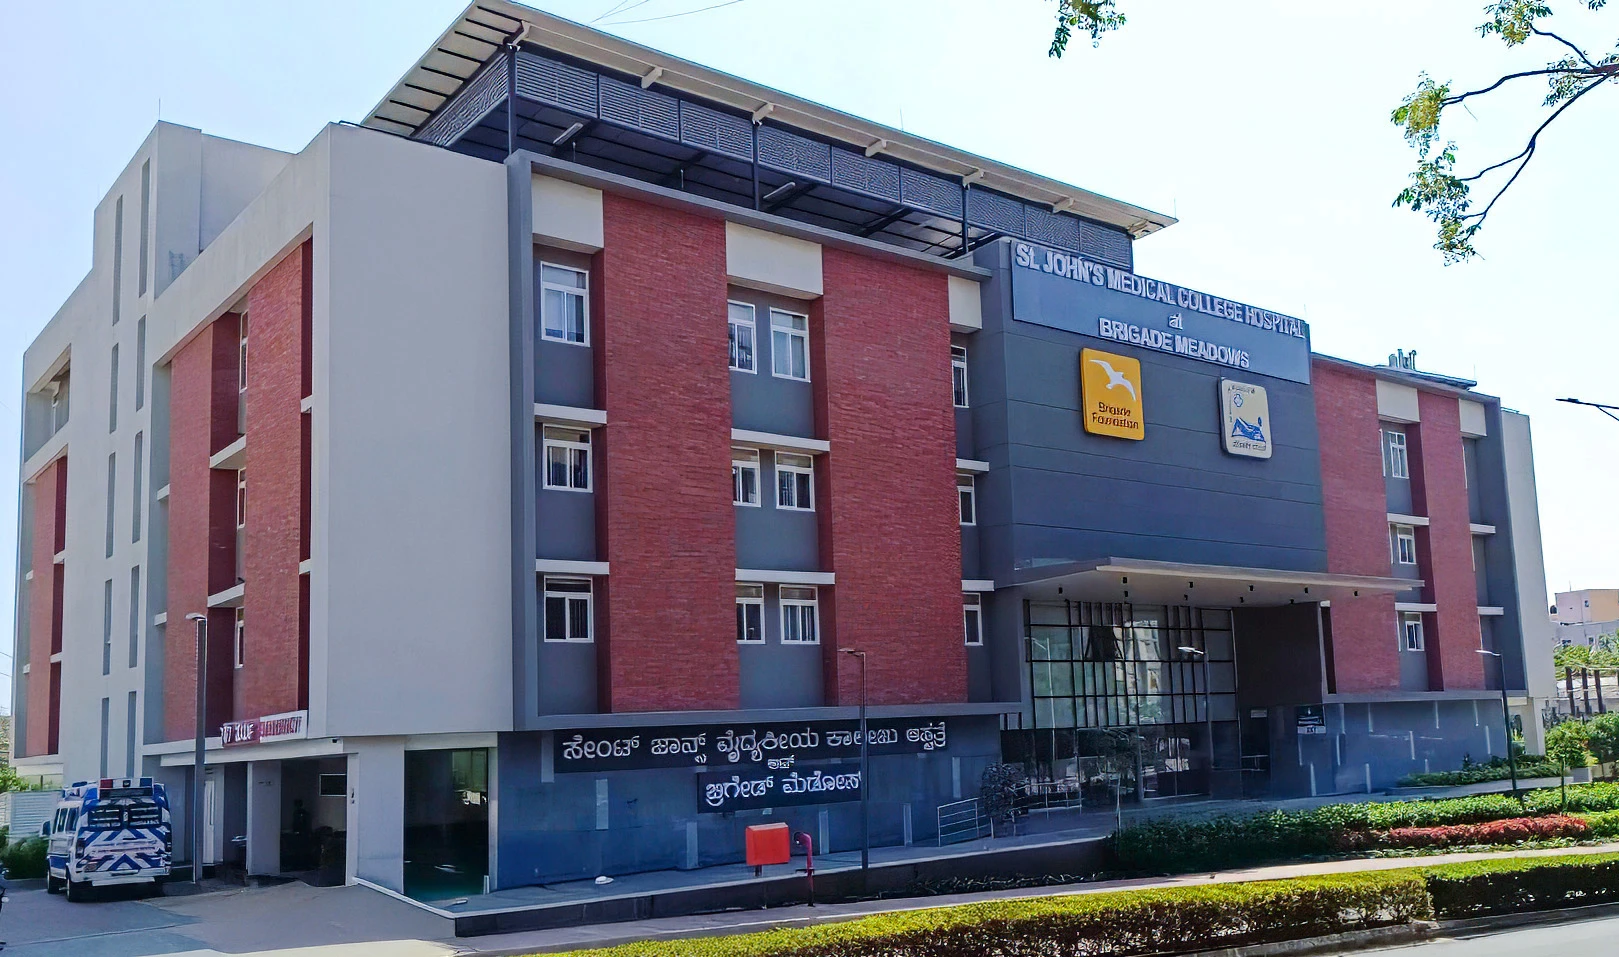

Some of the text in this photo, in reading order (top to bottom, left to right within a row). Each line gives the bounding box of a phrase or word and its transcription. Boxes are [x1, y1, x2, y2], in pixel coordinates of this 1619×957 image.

[1042, 250, 1105, 286] JOHN'S
[1106, 266, 1177, 305] MEDICAL
[1177, 288, 1243, 322] COLLEGE
[1245, 305, 1306, 339] HOSPITAL
[1099, 317, 1250, 368] BRIGADE MEADOWS
[562, 734, 640, 760] ಸೇಂಟ್
